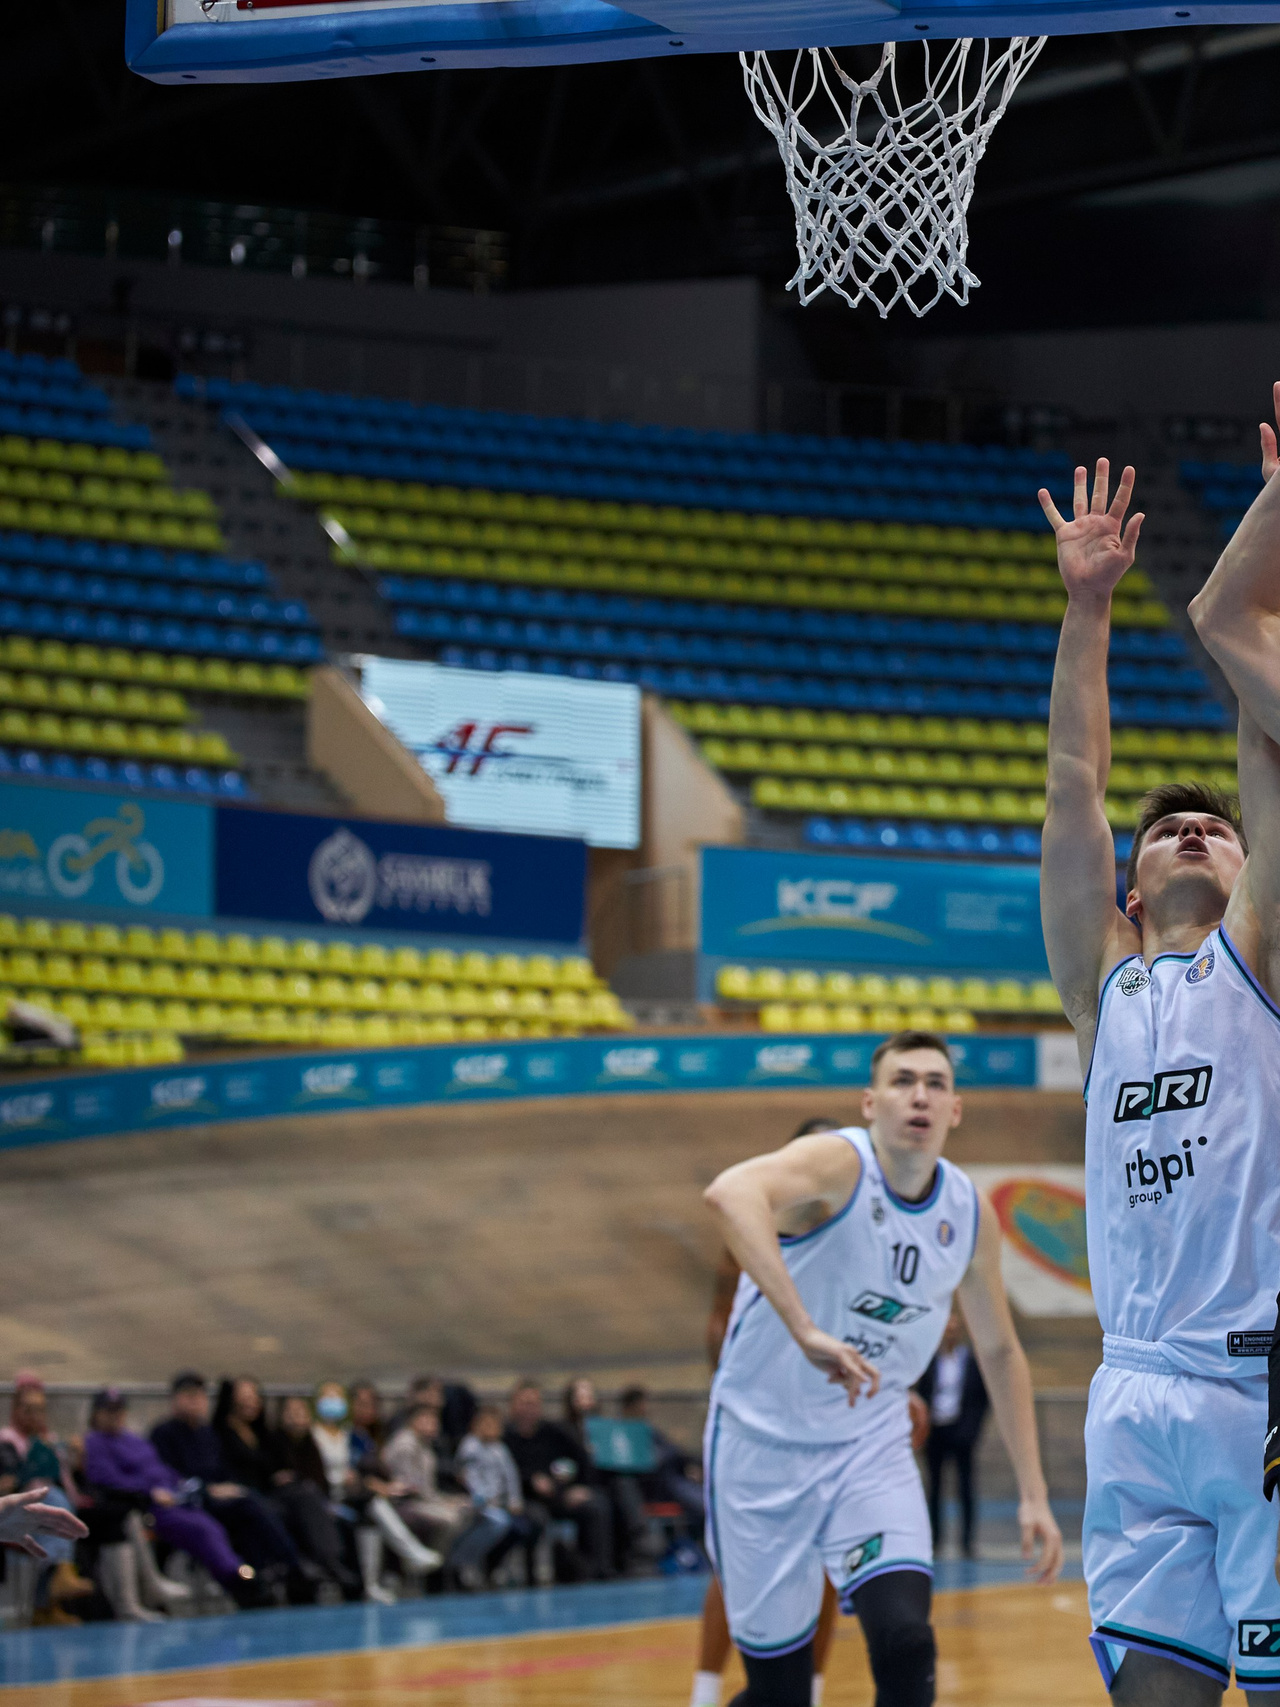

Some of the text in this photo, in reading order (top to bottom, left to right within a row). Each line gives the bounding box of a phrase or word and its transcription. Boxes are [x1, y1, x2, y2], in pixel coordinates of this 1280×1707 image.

[777, 878, 899, 918] KCF
[1125, 1136, 1208, 1195] rbpi
[1129, 1191, 1163, 1208] group
[891, 1242, 920, 1285] 10
